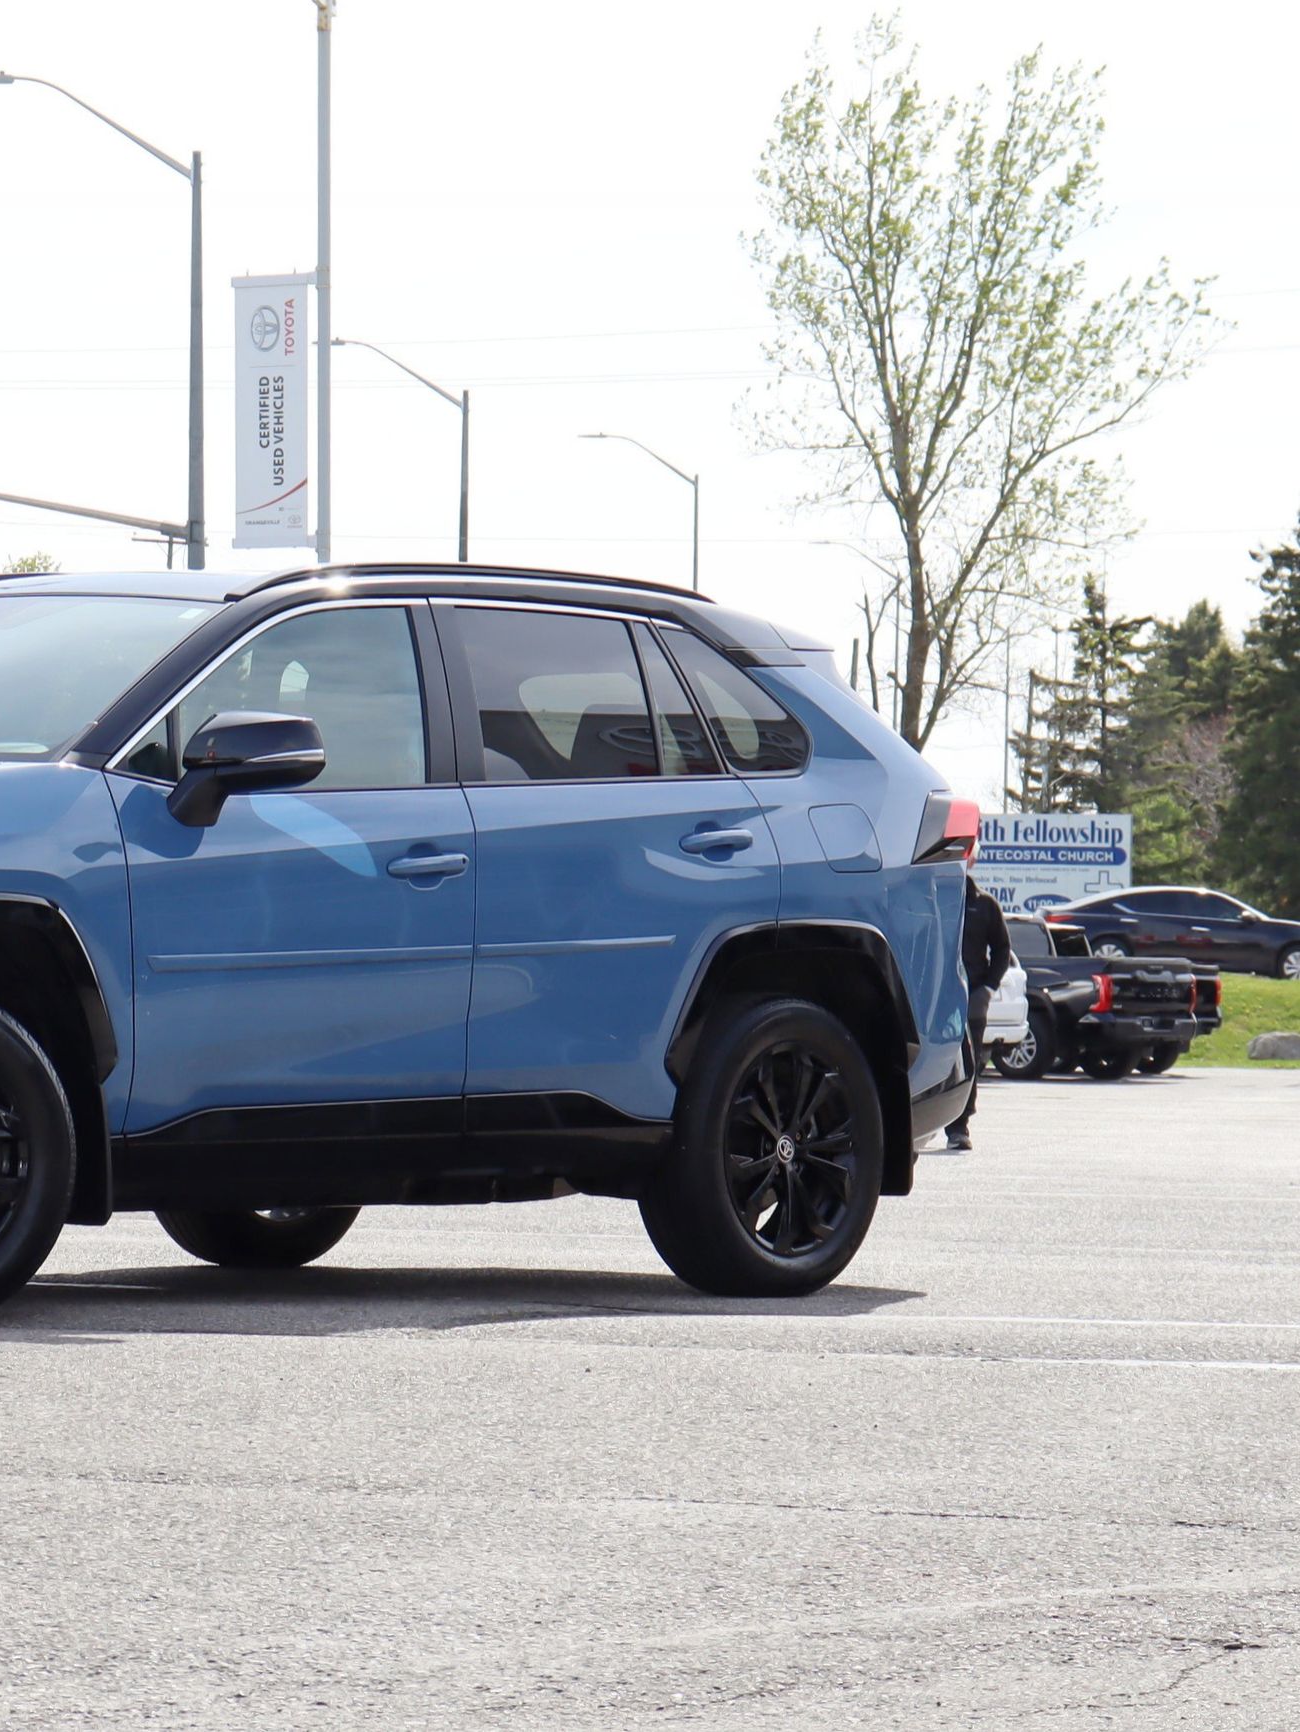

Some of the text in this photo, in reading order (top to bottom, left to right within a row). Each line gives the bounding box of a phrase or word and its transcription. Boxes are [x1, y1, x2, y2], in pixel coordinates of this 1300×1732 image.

[284, 298, 295, 356] TOYOTA
[259, 375, 270, 449] CERTIFIED
[273, 375, 285, 486] USED VEHICLES
[978, 819, 1123, 848] ith Fellowship
[978, 850, 1114, 862] NTECOSTAL CHURCH
